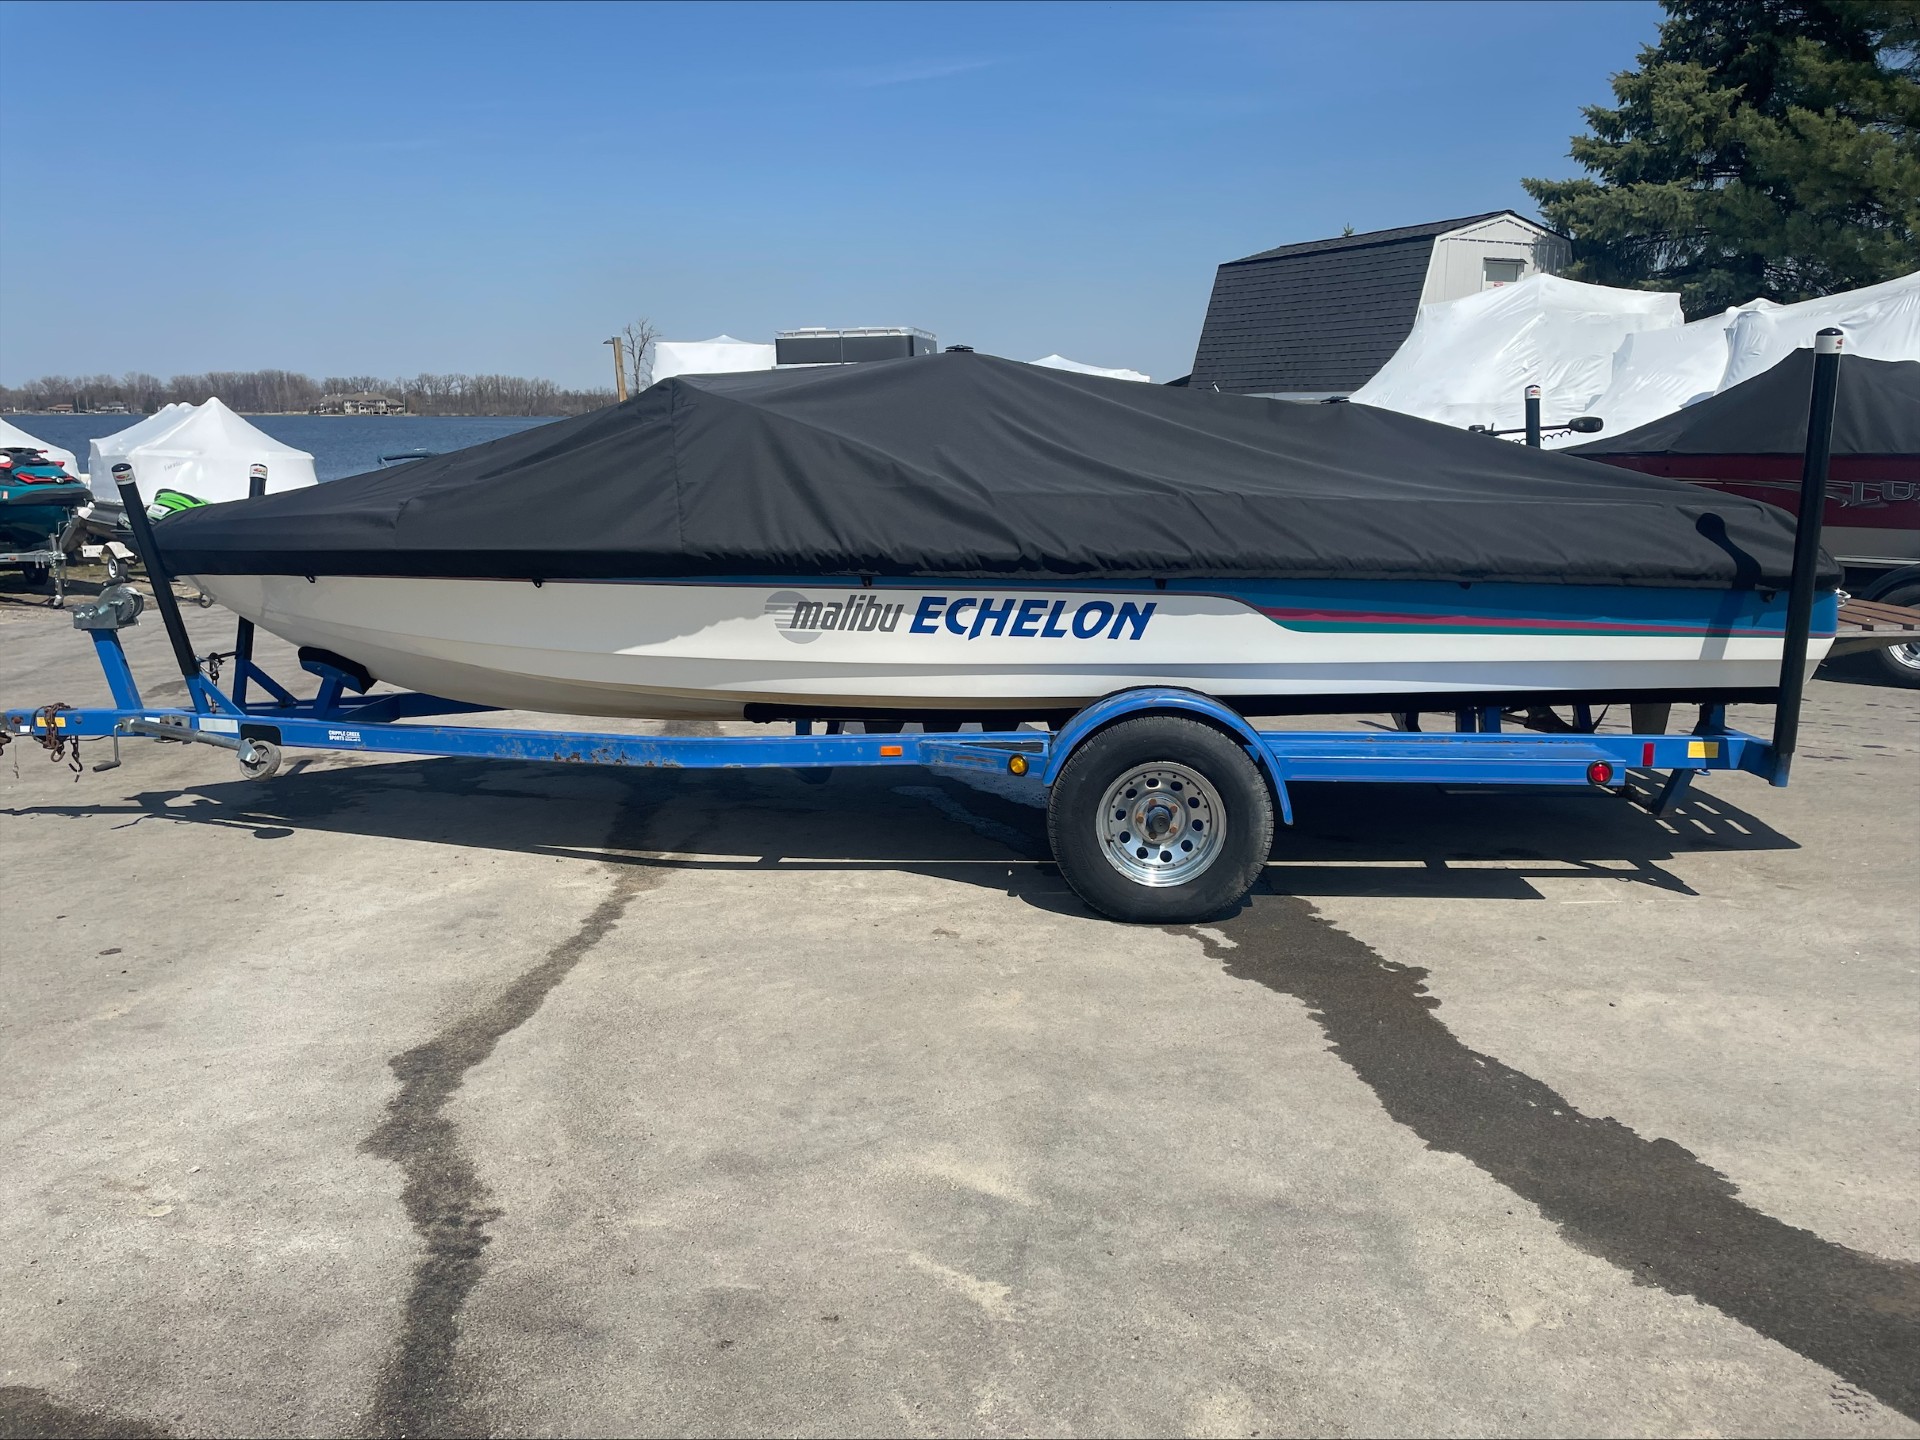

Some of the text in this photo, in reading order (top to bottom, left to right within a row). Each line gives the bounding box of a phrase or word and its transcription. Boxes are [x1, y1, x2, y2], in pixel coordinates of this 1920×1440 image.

[1849, 481, 1920, 507] LU
[790, 594, 1157, 641] malibu ECHELON
